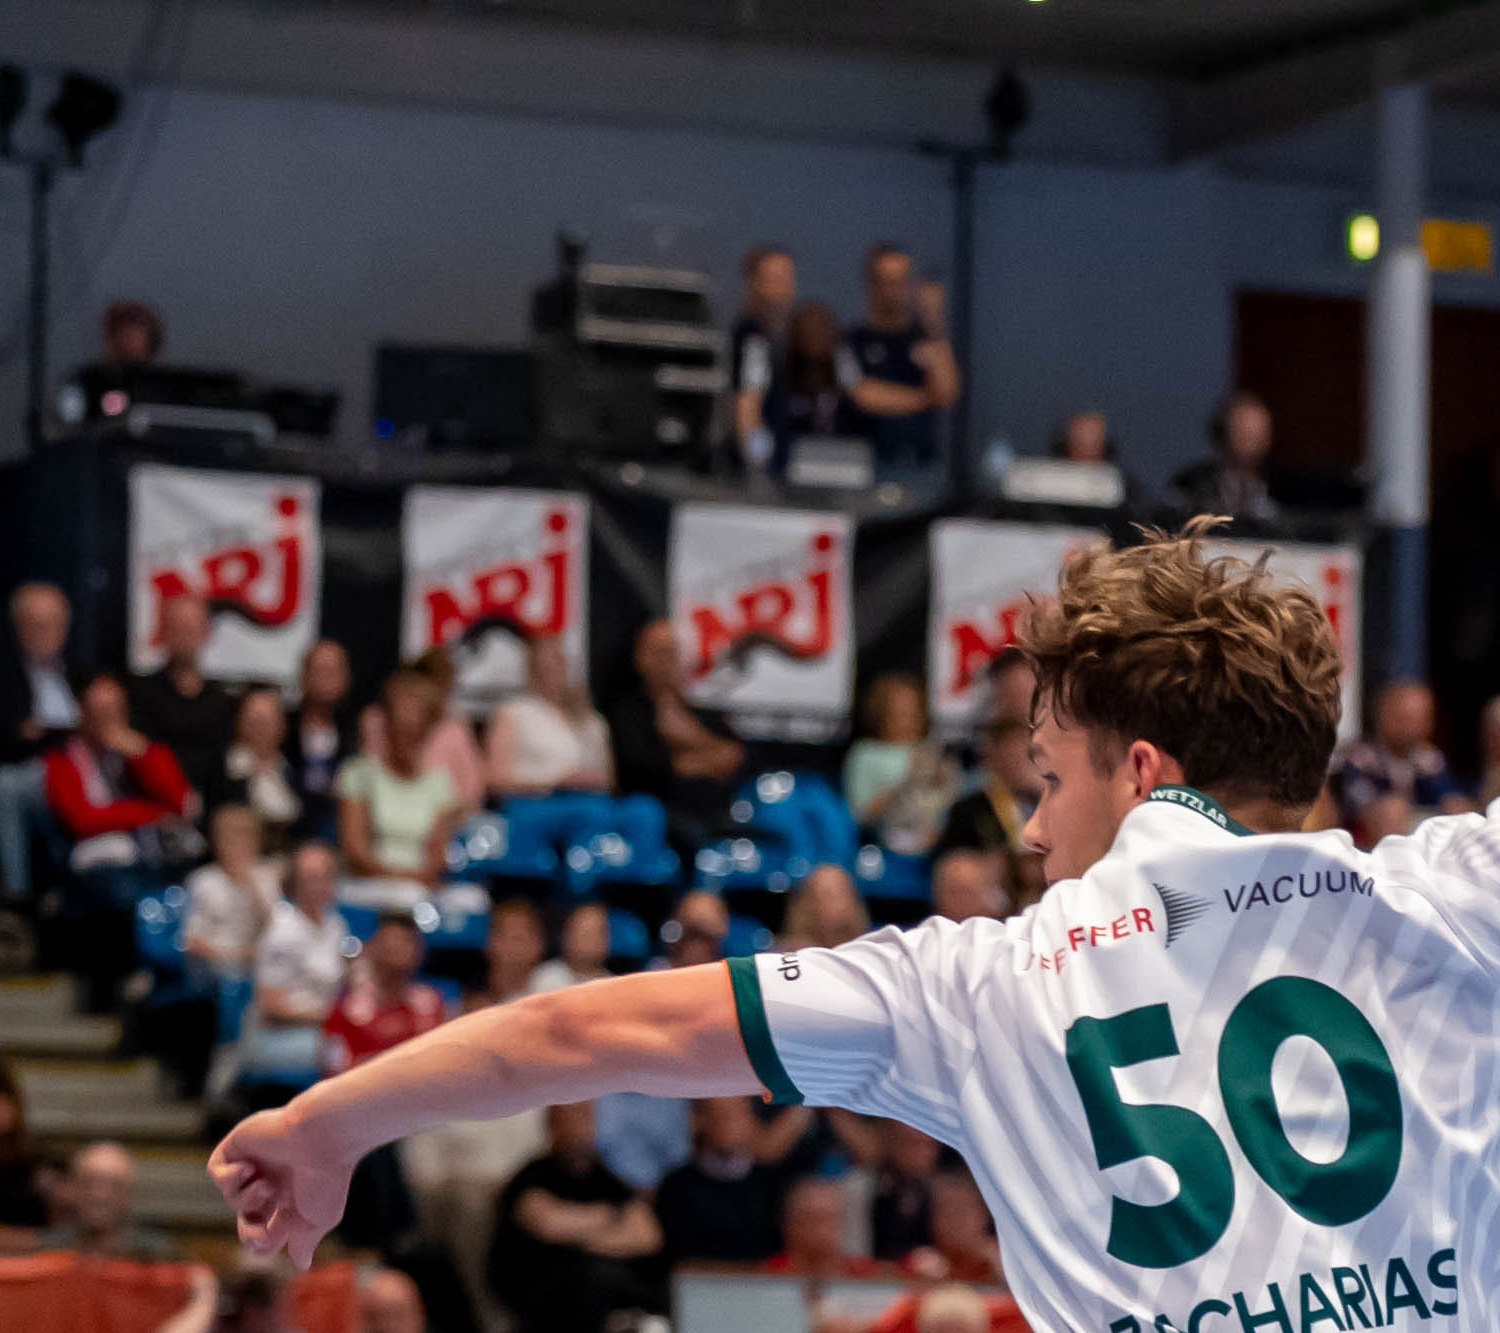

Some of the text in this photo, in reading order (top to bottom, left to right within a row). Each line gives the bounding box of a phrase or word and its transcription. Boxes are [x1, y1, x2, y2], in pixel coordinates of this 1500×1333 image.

[1150, 789, 1229, 829] WETZLAR
[1224, 870, 1376, 914] VACUUM
[1065, 975, 1404, 1270] 50
